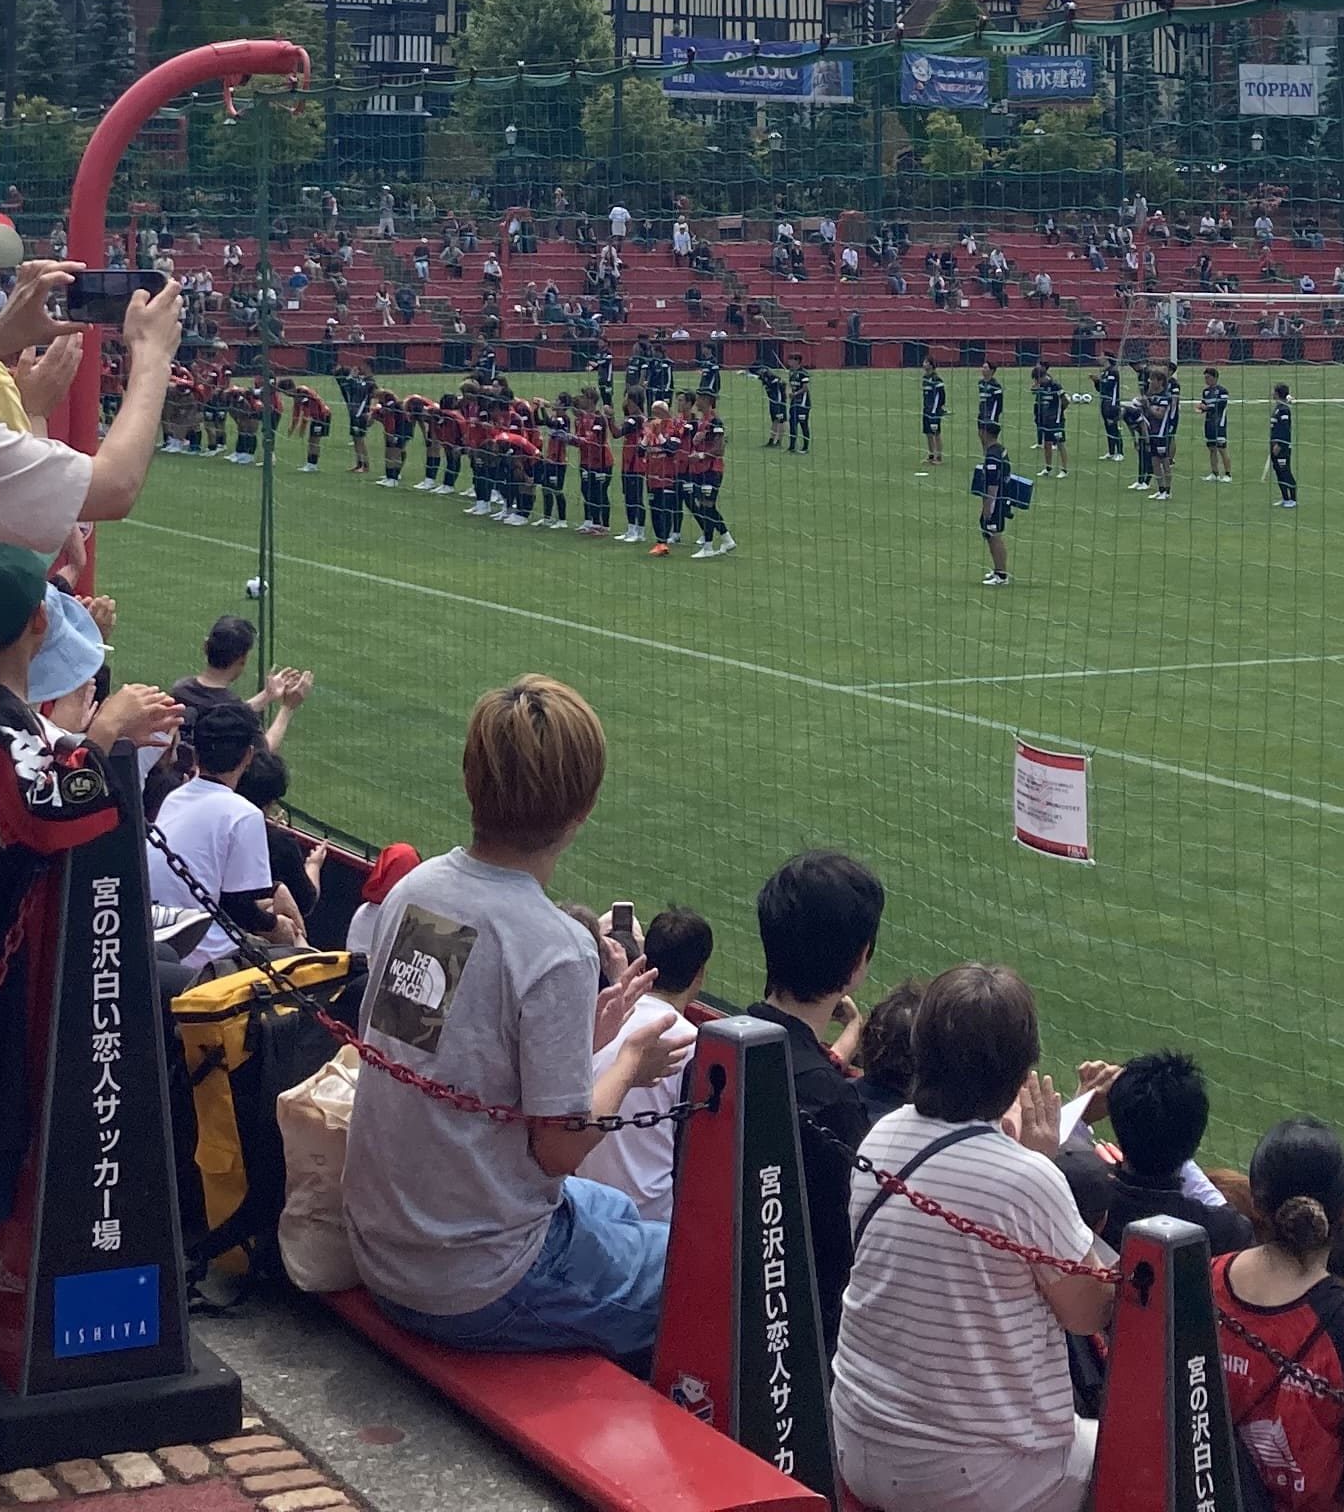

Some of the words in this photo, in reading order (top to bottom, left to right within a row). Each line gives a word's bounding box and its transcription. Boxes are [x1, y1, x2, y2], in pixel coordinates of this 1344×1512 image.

[1016, 68, 1087, 90] 清水建設
[1245, 82, 1313, 98] TOPPAN
[389, 958, 426, 986] NORTH
[412, 950, 432, 970] THE
[391, 976, 424, 1002] FACE
[92, 876, 122, 1252] 宮の沢白い恋人サッカー場
[65, 1320, 147, 1345] ISHIYA
